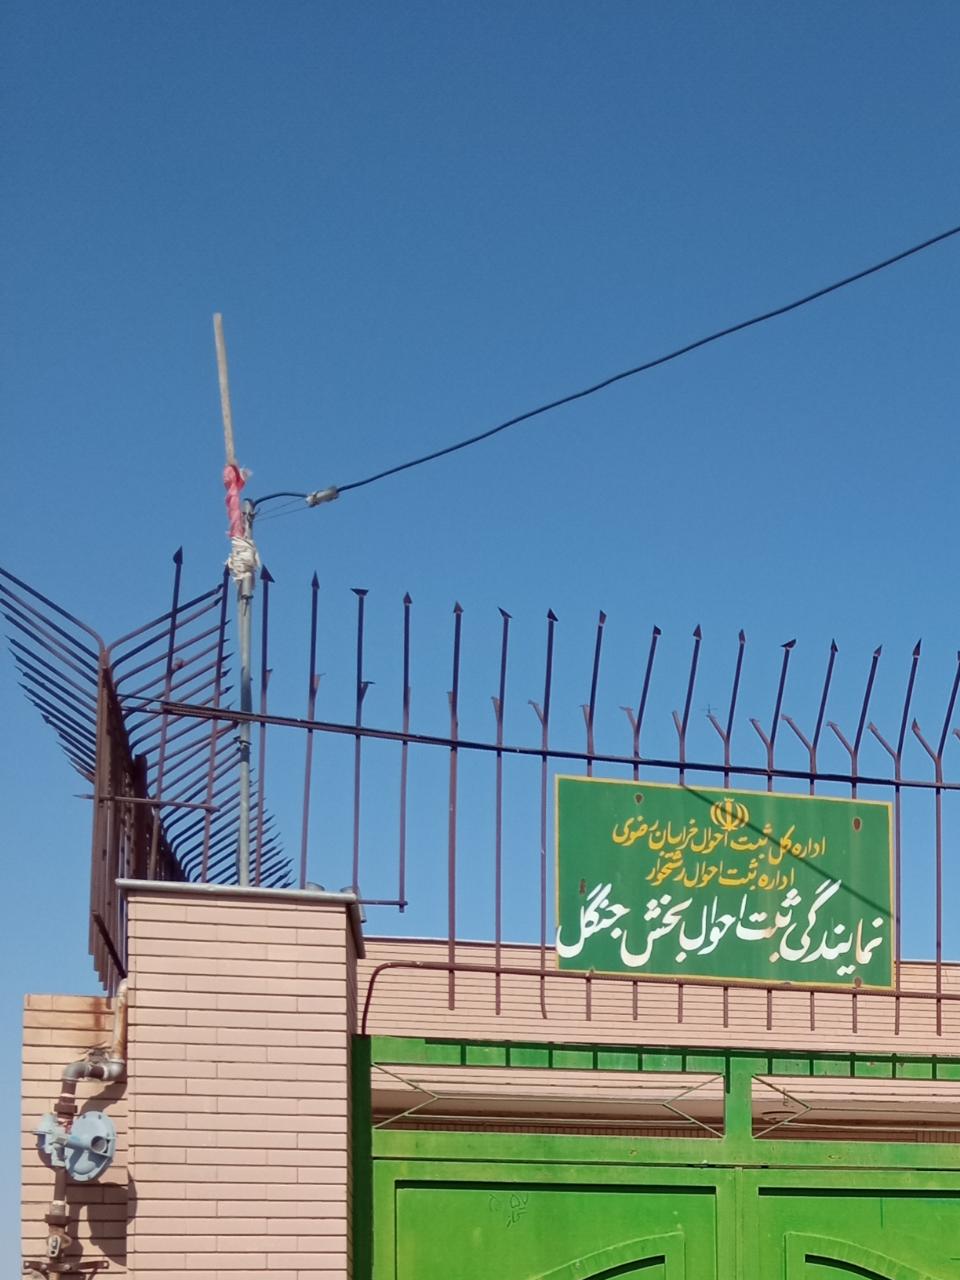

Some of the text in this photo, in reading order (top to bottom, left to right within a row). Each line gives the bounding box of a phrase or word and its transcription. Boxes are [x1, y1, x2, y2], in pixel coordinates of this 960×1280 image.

[612, 815, 826, 865] اداره کل ثبت احوال خراسان رضوی
[645, 850, 795, 891] اداره ثبت احوال رشتخوار
[556, 879, 884, 977] نمایندگی ثبت احوال بخش جنگل
